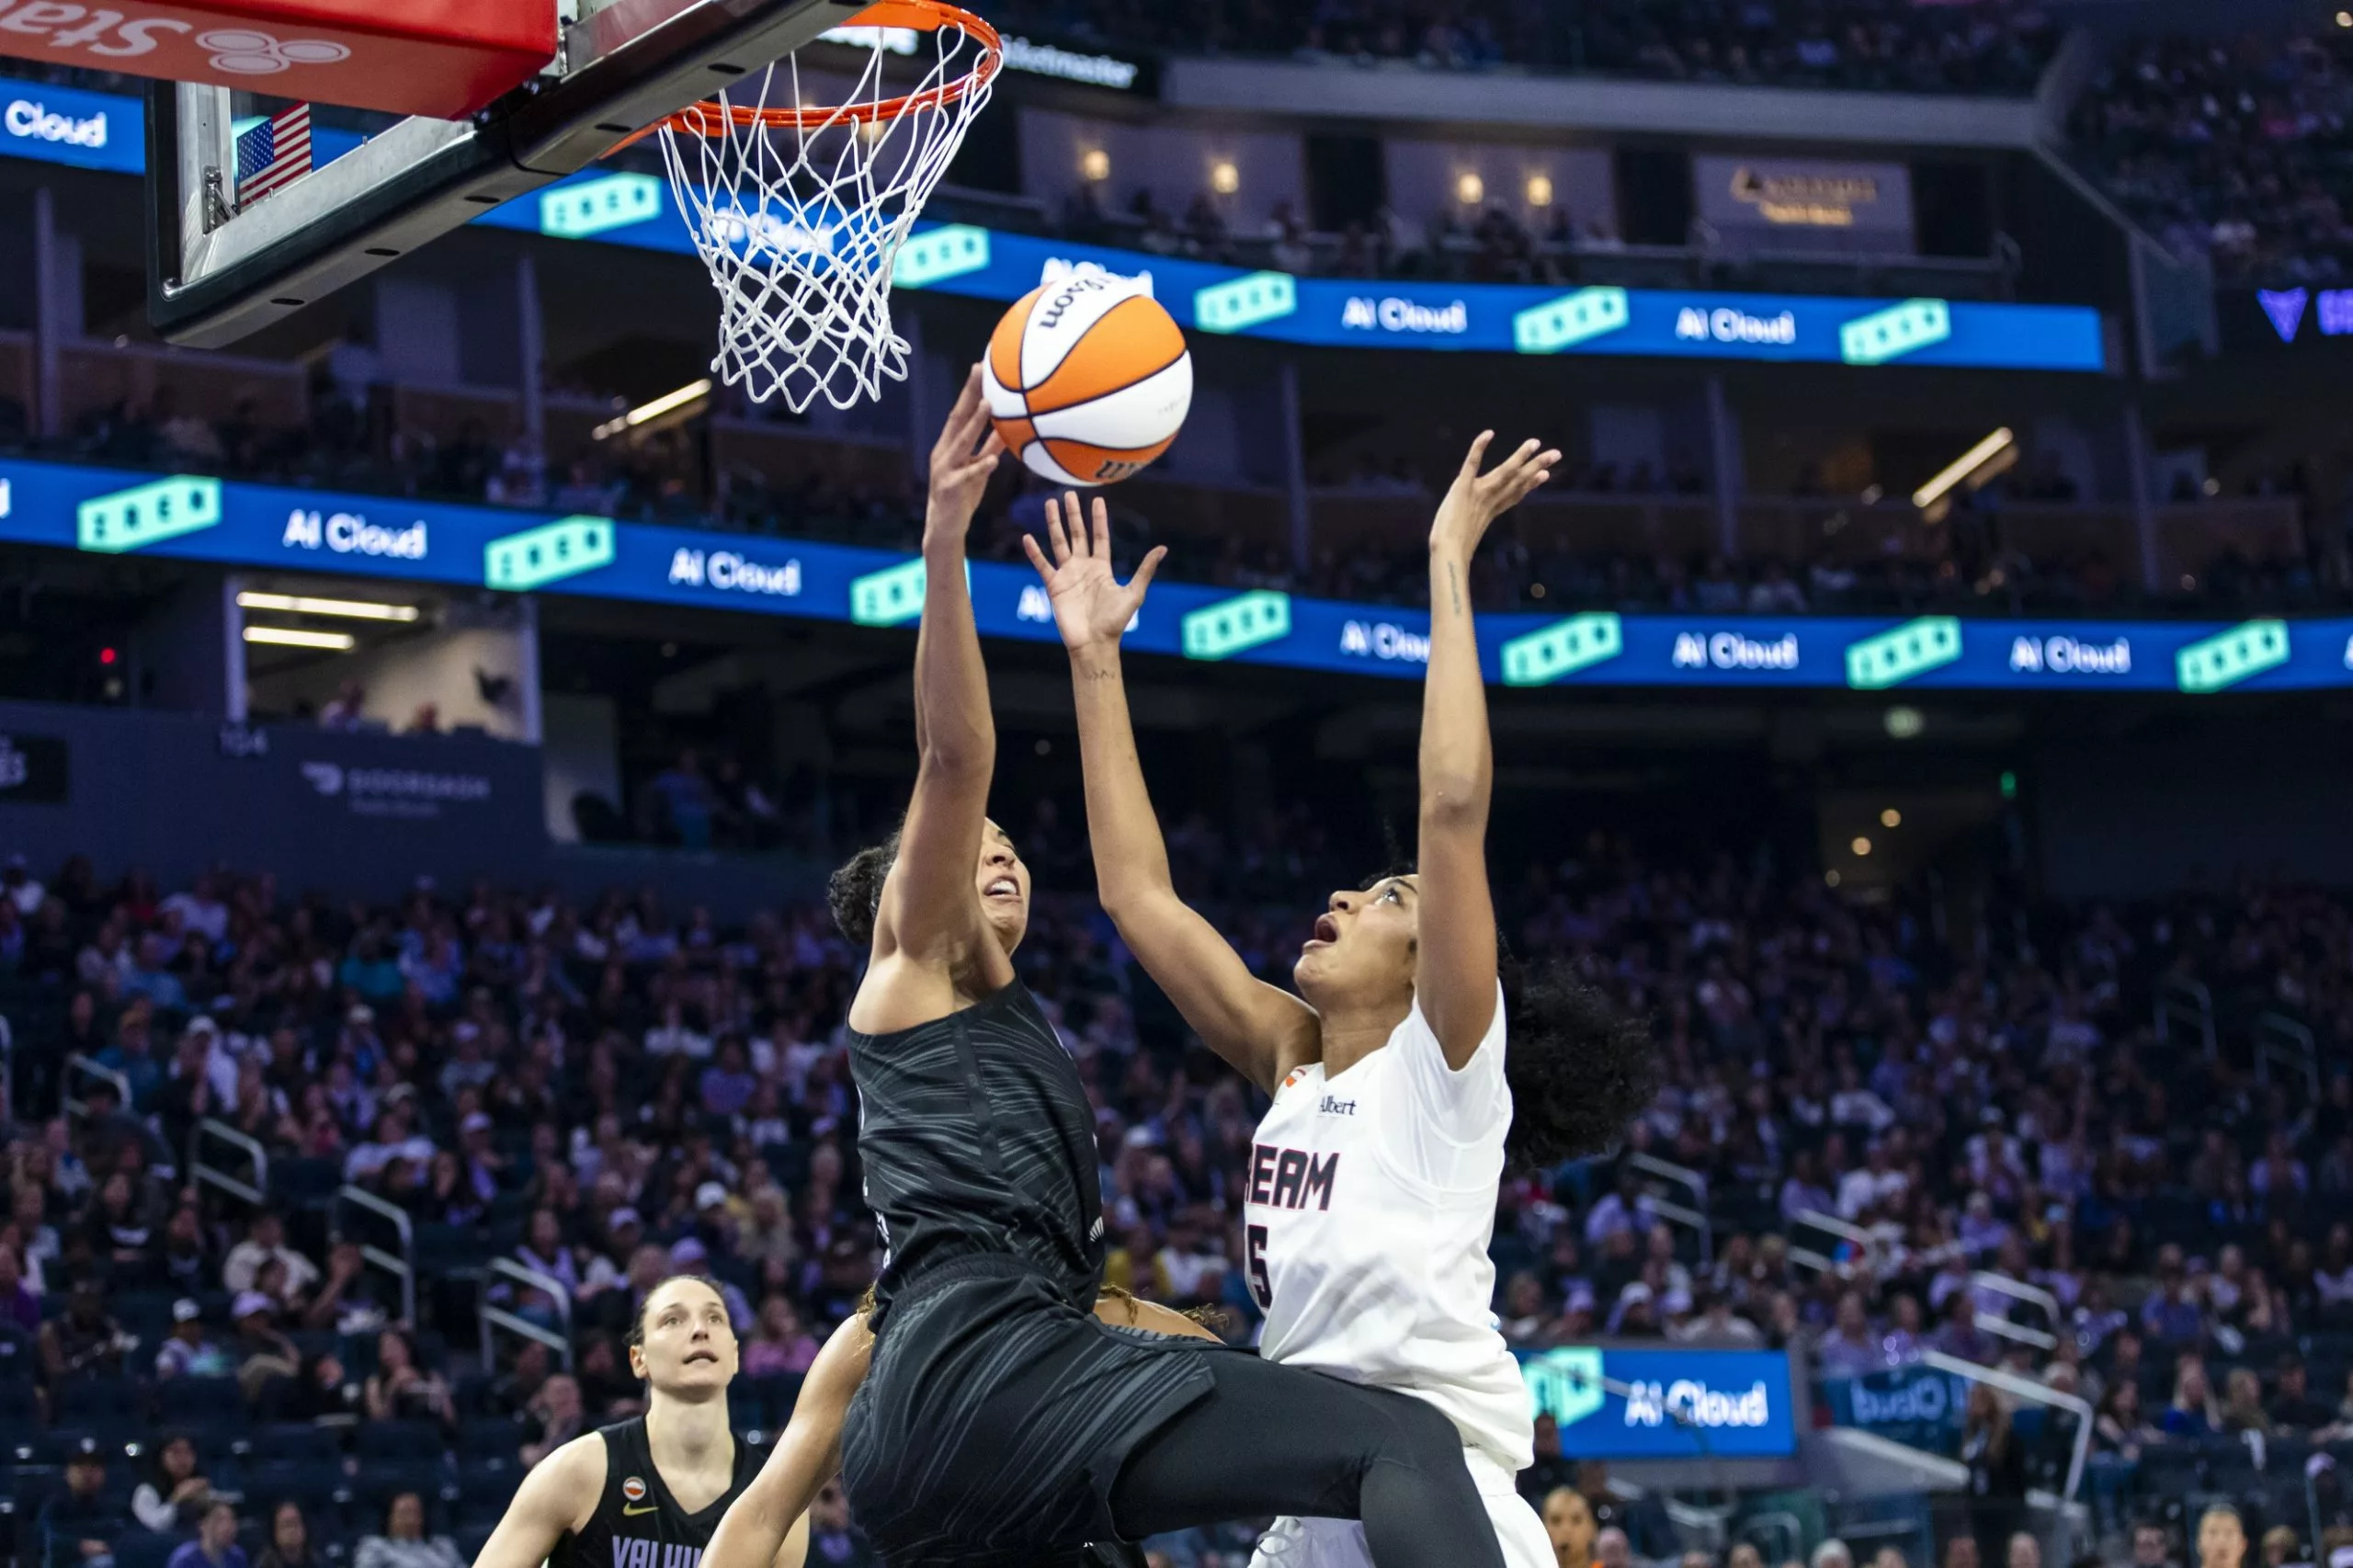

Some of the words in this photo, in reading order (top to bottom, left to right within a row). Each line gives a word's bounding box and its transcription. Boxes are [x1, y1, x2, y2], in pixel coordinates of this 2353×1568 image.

[5, 99, 108, 149] Cloud
[1342, 296, 1377, 331] AI
[1378, 297, 1468, 334] Cloud
[1675, 307, 1710, 341] AI
[1710, 307, 1796, 345] Cloud
[282, 508, 322, 550] AI
[324, 512, 427, 560] Cloud
[668, 547, 705, 586] AI
[707, 551, 801, 597] Cloud
[1340, 619, 1372, 657] AI
[1672, 631, 1708, 669] AI
[1709, 631, 1799, 669] Cloud
[2009, 635, 2043, 673] AI
[2045, 635, 2131, 674] Cloud
[1624, 1379, 1663, 1427] AI
[1665, 1379, 1768, 1427] Cloud
